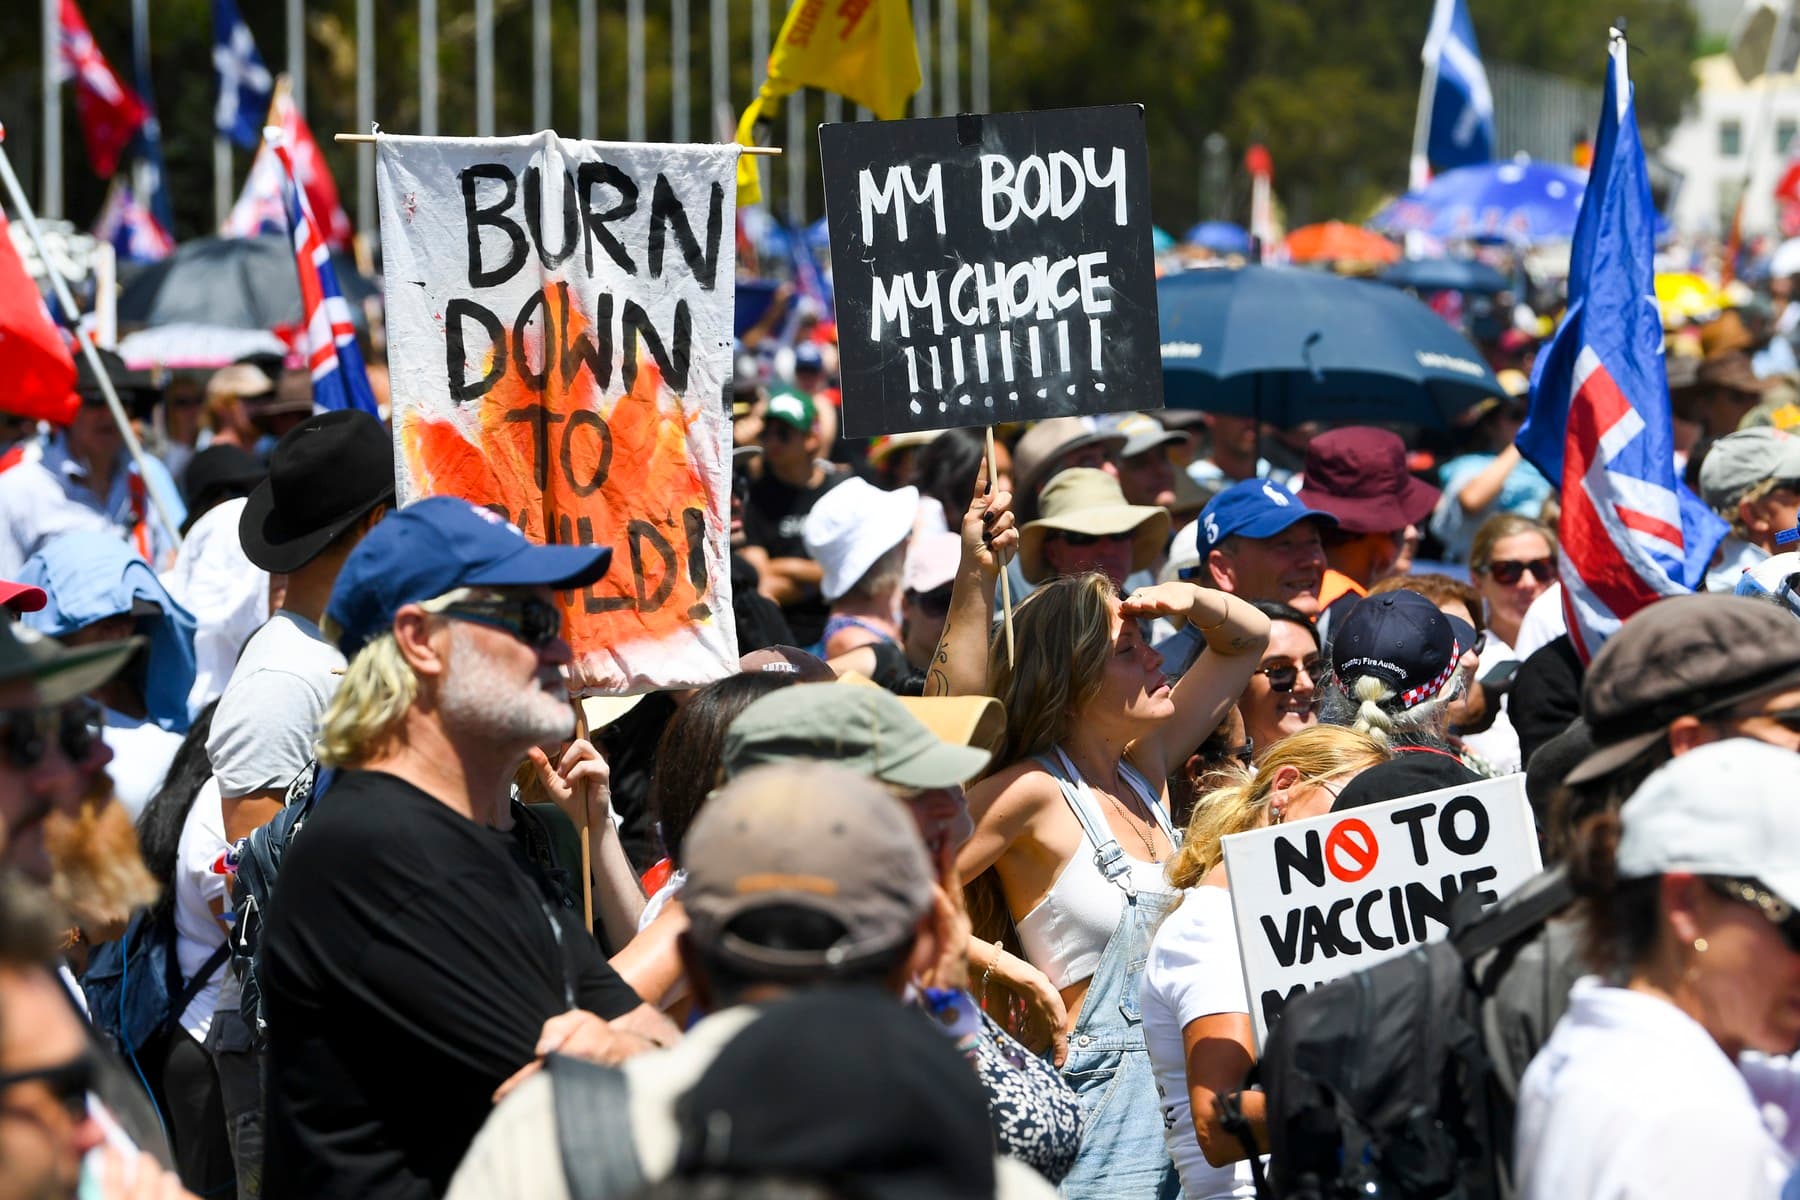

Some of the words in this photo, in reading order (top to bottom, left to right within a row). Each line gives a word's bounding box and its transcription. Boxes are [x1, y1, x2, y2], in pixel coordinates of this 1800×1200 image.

[458, 161, 724, 290] BURN
[859, 163, 946, 246] MY
[979, 147, 1128, 231] BODY
[445, 280, 691, 401] DOWN
[871, 271, 943, 341] MY
[949, 252, 1112, 326] CHOICE
[505, 404, 612, 496] TO
[1341, 658, 1361, 671] Country
[1362, 657, 1378, 667] Fire
[1377, 659, 1408, 680] Authority
[1391, 795, 1490, 866] TO
